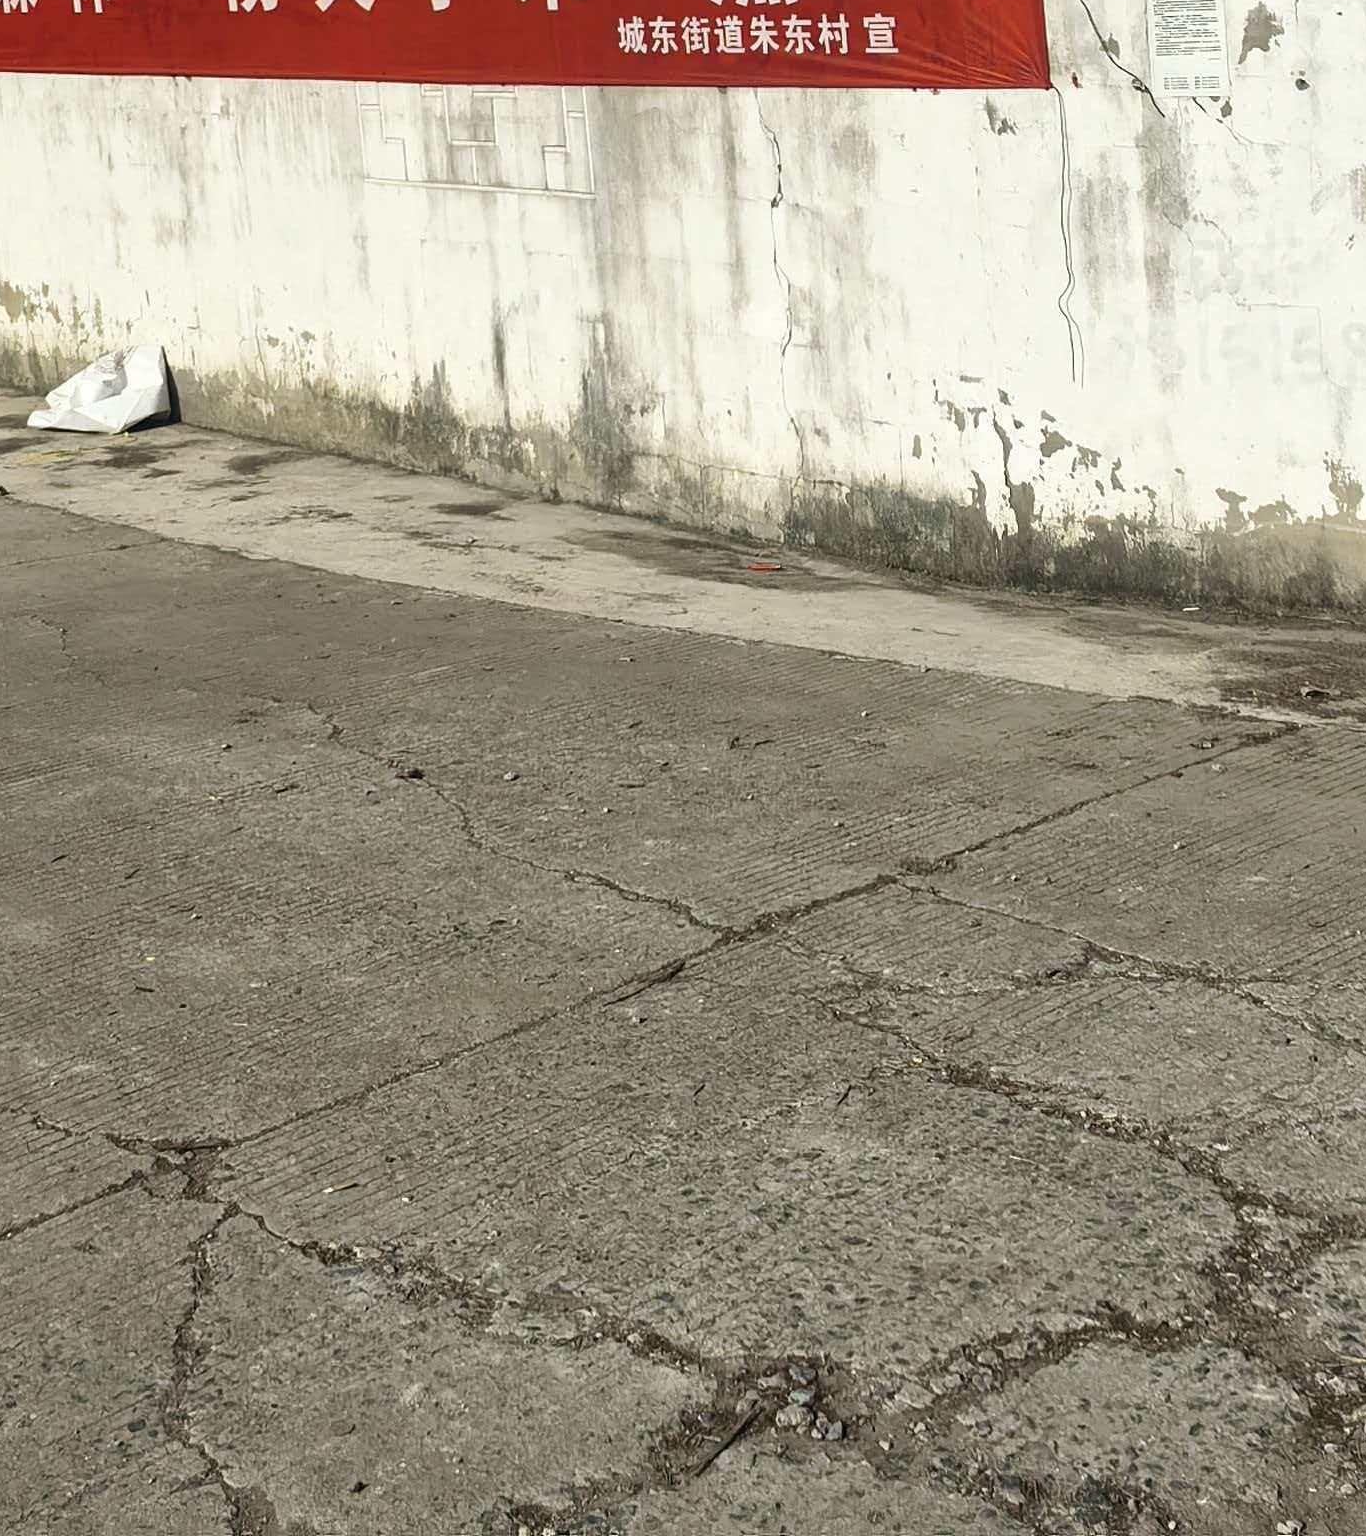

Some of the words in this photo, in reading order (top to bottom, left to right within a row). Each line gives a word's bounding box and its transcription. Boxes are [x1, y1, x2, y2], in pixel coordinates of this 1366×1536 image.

[618, 13, 849, 56] 城东街道朱东村
[864, 14, 899, 55] 宣
